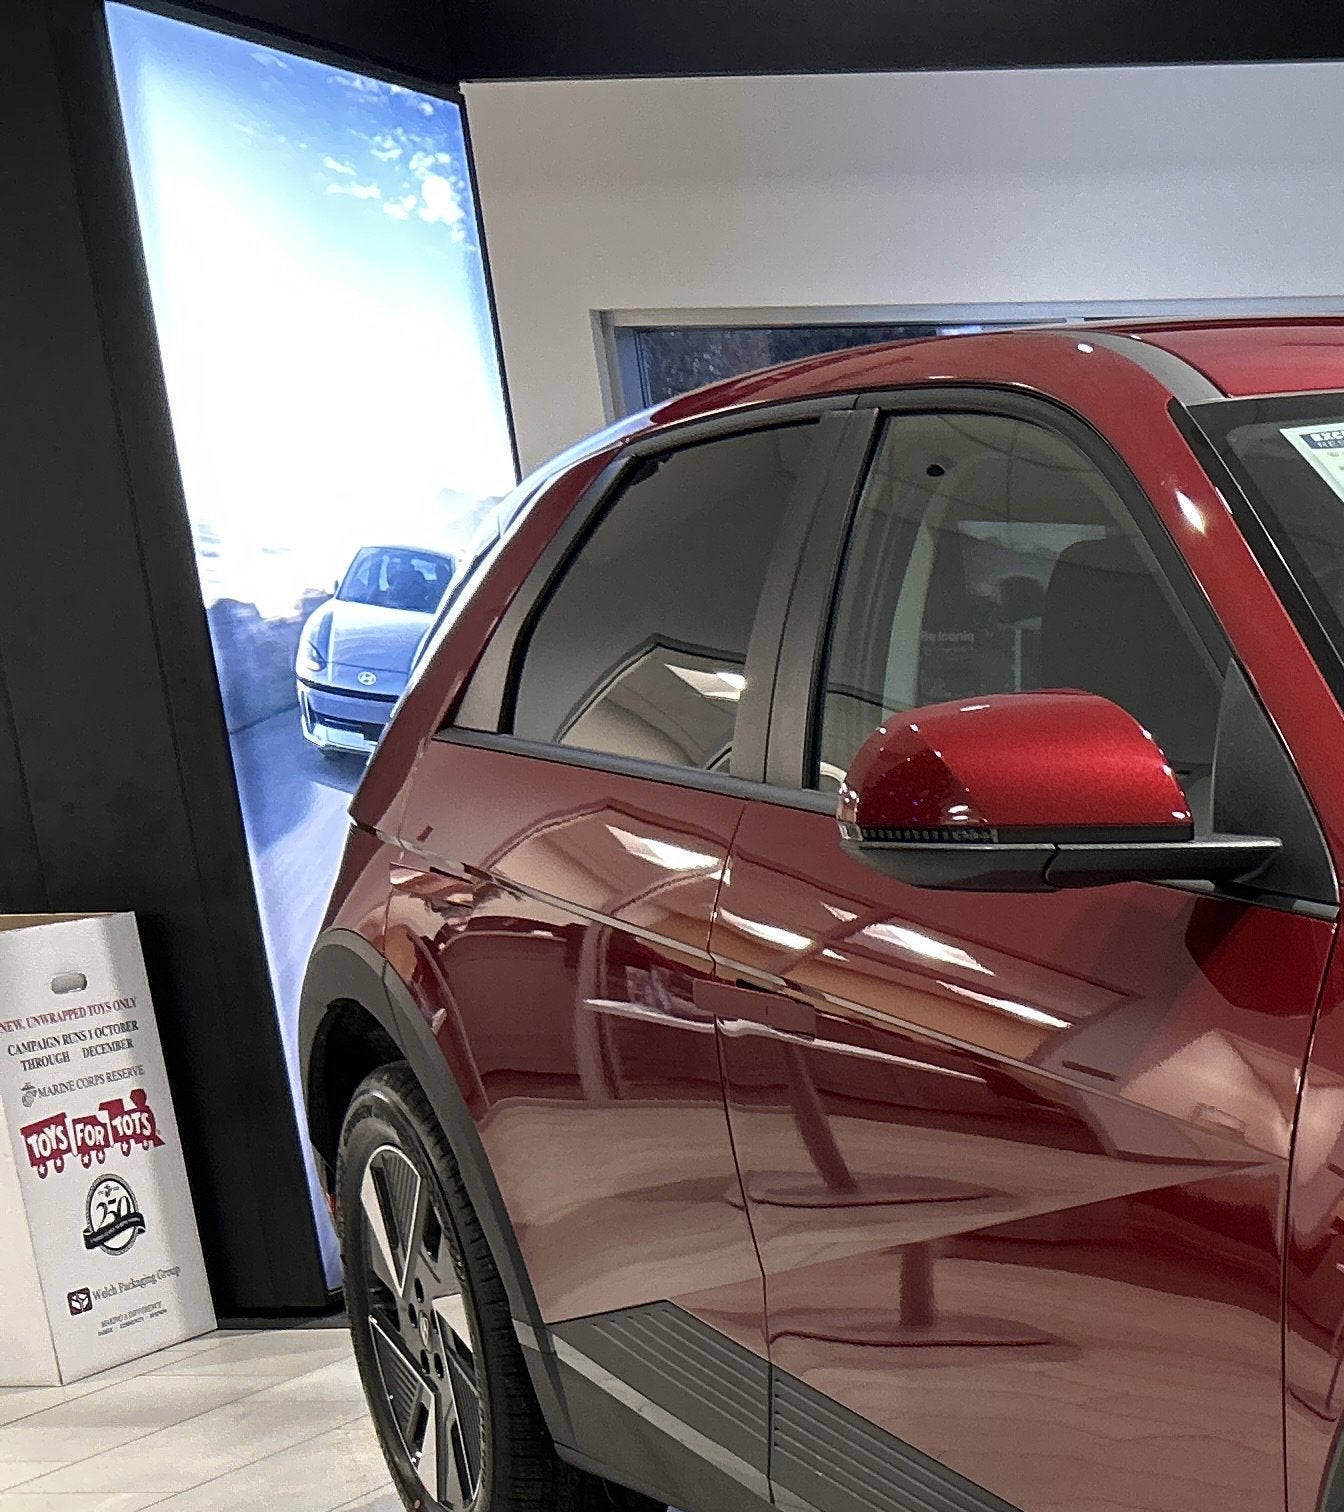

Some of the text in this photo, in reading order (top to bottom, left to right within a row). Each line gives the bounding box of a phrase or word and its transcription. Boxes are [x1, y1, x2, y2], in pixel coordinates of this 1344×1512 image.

[26, 1006, 86, 1028] UNWRAPPED
[87, 1001, 112, 1016] TOYS
[113, 997, 136, 1011] ONLY
[7, 1038, 61, 1056] CAMPAIGN
[62, 1030, 87, 1045] RUNS
[95, 1020, 139, 1039] OCTOBER
[20, 1038, 134, 1072] THROUGH DECEMBER
[37, 1065, 145, 1099] MARINE CORPS RESERVE
[26, 1112, 151, 1158] TOYS FOR TOTS
[96, 1196, 131, 1229] 250
